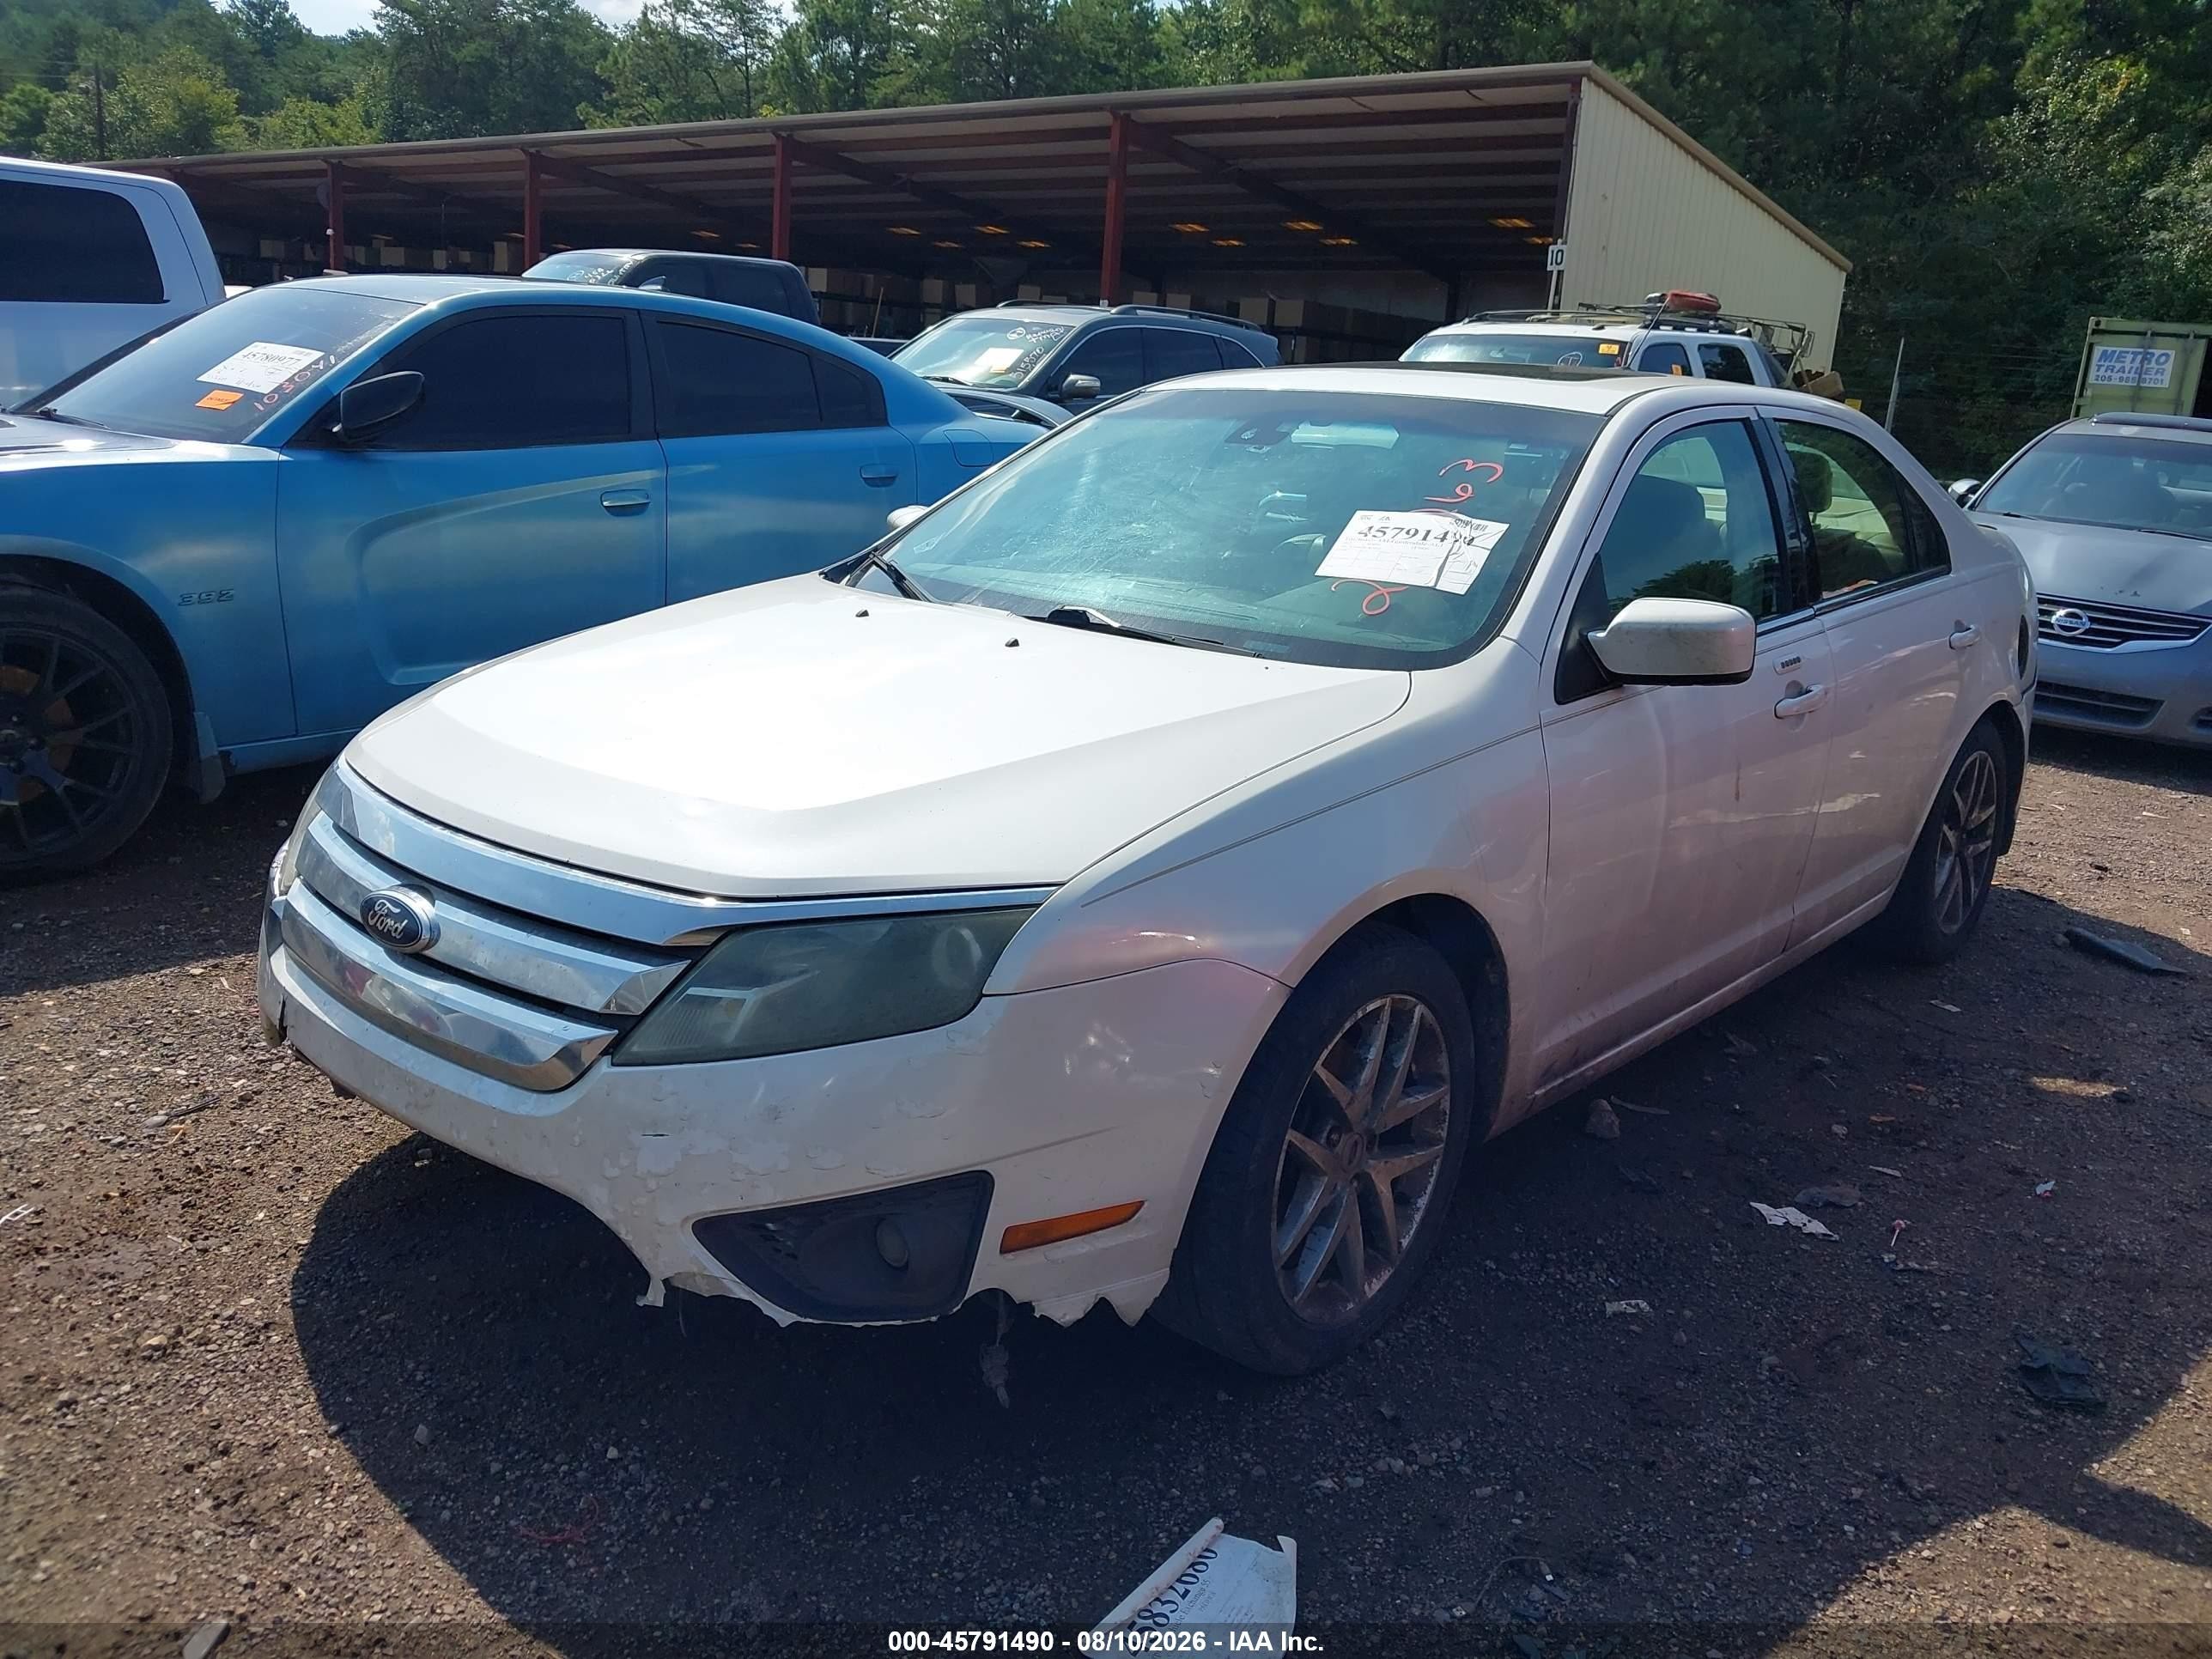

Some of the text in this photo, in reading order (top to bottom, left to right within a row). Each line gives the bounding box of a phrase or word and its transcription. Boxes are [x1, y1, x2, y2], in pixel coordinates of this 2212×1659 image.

[1549, 249, 1565, 266] 10
[2097, 349, 2172, 367] METRO
[2095, 363, 2167, 377] TRAILER
[2055, 617, 2087, 627] NISSAN
[368, 899, 409, 939] Ford
